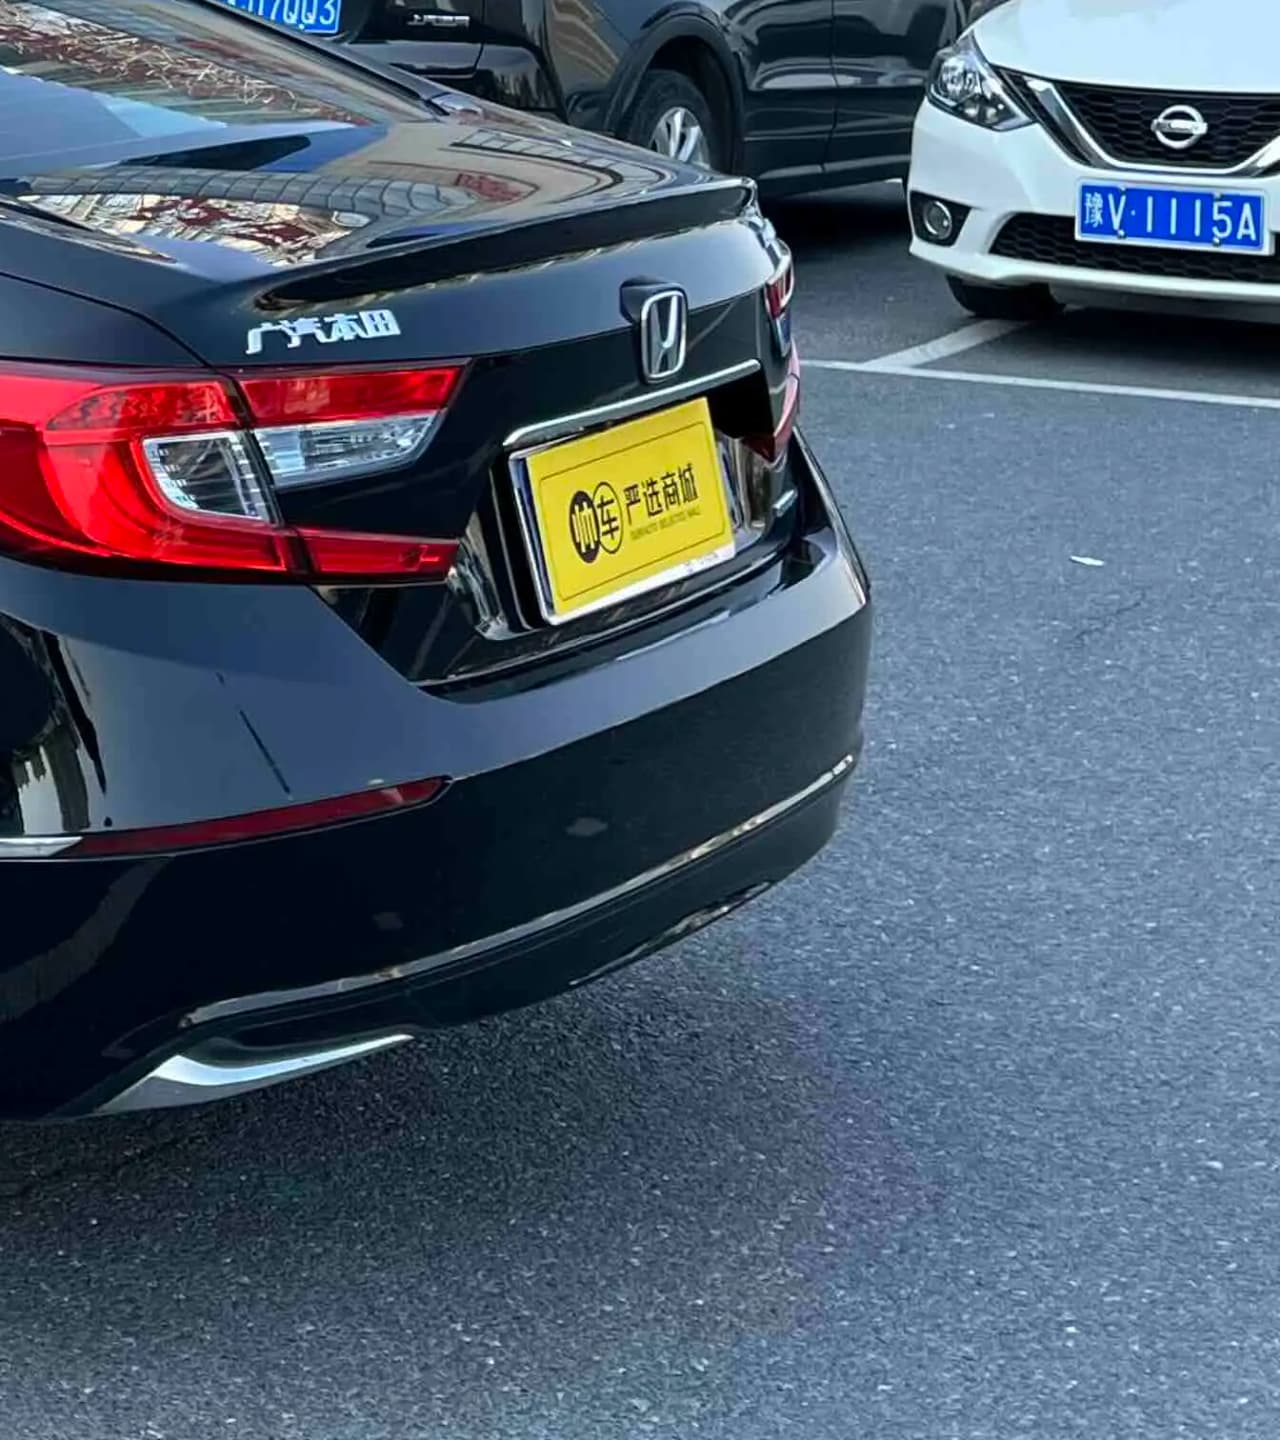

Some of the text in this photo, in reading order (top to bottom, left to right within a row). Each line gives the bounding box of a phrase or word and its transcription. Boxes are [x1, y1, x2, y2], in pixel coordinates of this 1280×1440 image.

[246, 309, 401, 355] 广汽本田
[623, 463, 699, 526] 严选商城
